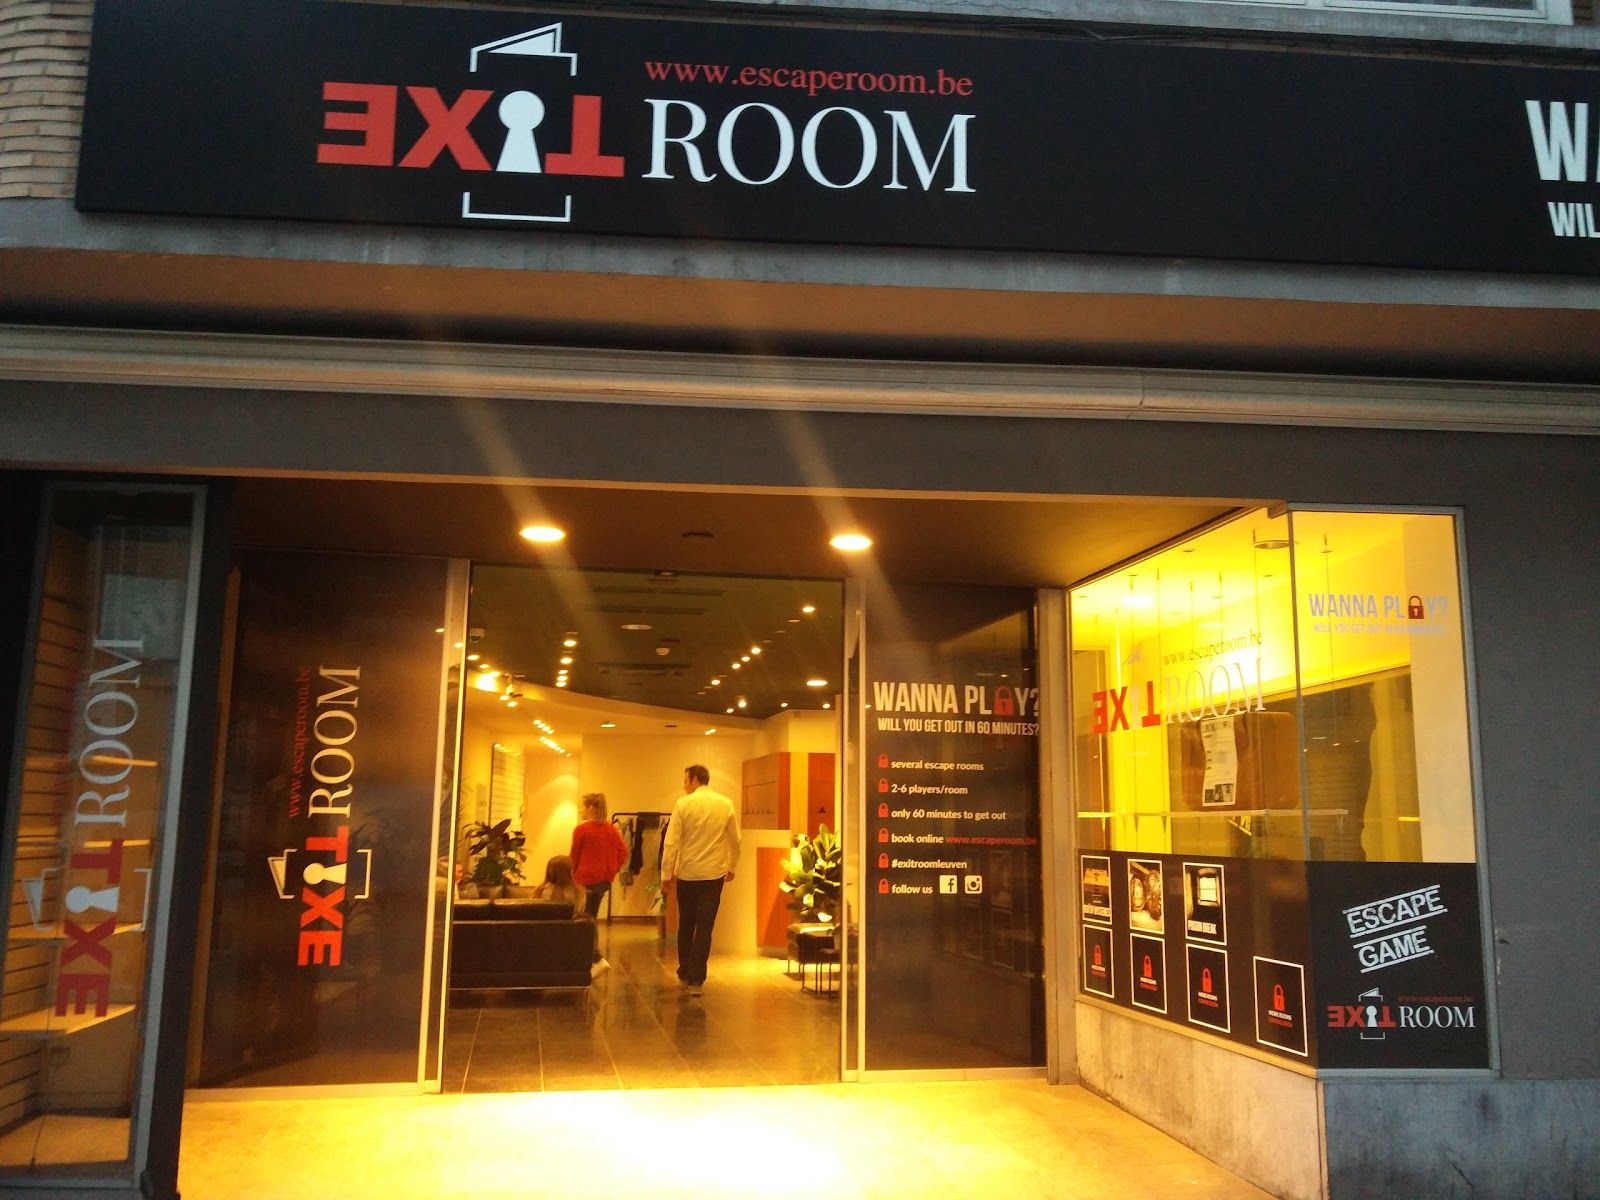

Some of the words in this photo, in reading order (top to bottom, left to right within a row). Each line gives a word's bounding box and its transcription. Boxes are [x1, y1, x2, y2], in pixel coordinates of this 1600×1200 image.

[644, 58, 974, 98] www.escaperoom.be
[642, 98, 977, 194] ROOM
[1308, 593, 1378, 618] WANNA
[873, 682, 959, 714] WANNA
[73, 637, 144, 828] ROOM
[878, 717, 901, 731] WILL
[903, 718, 923, 732] YOU
[924, 719, 943, 733] GET
[945, 720, 964, 733] OUT
[965, 720, 976, 733] IN
[977, 721, 991, 734] 60
[308, 665, 361, 819] ROOM
[891, 760, 923, 769] several
[924, 761, 955, 771] escape
[956, 763, 985, 771] rooms
[891, 783, 908, 793] 2-6
[908, 784, 969, 795] players/room
[891, 809, 911, 820] only
[912, 809, 925, 818] 60
[926, 810, 962, 819] minutes
[963, 811, 973, 819] to
[974, 812, 990, 821] get
[991, 812, 1007, 820] out
[891, 834, 915, 843] book
[916, 834, 944, 844] online
[891, 859, 968, 869] #exitroomleuven
[891, 884, 920, 894] follow
[922, 886, 933, 894] us
[1347, 889, 1444, 934] ESCAPE
[1358, 930, 1431, 968] GAME
[1399, 1005, 1476, 1028] ROOM
